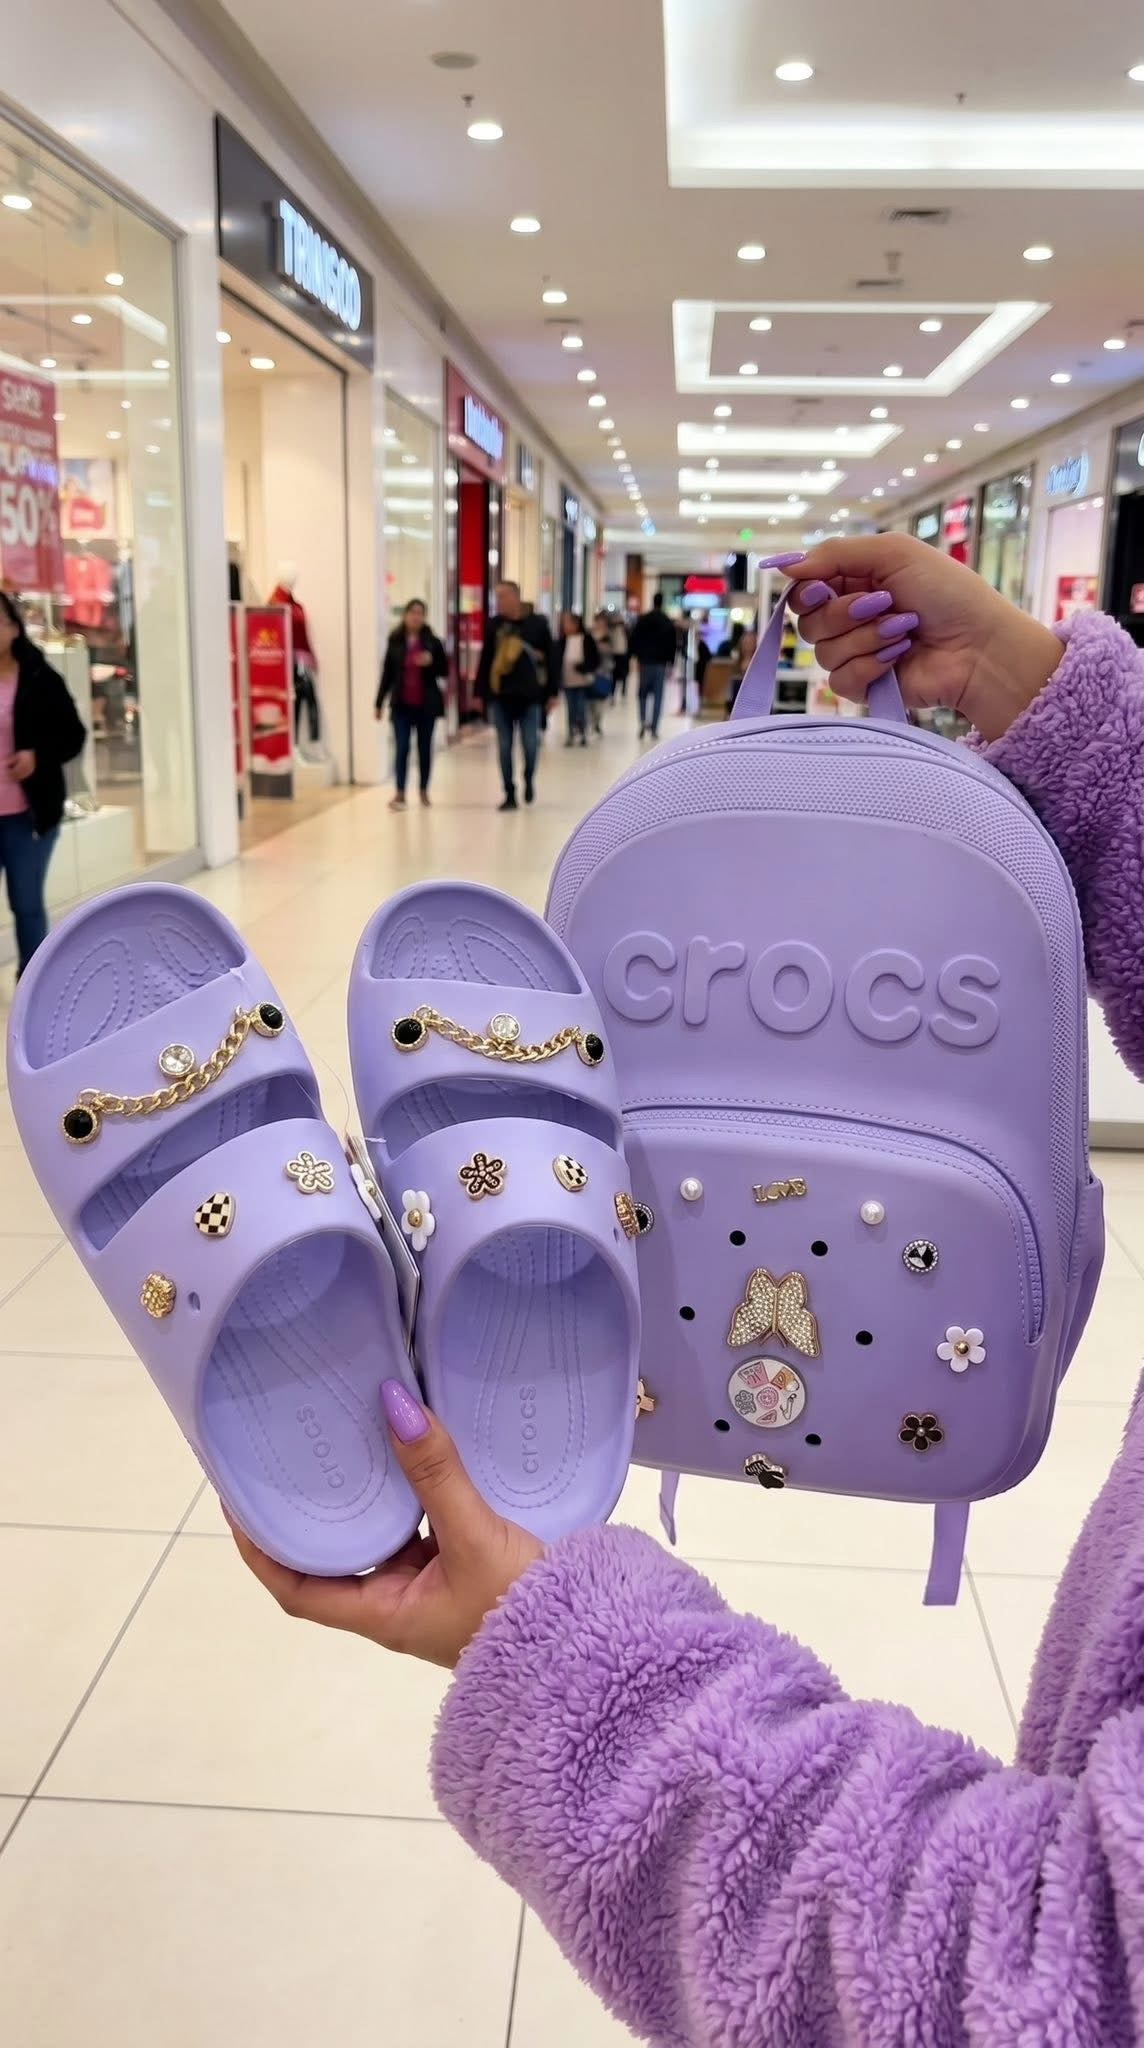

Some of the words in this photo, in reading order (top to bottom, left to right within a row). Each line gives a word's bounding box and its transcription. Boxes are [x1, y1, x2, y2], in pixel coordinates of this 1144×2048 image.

[603, 930, 1001, 1050] crocs
[296, 1404, 345, 1489] crocs
[520, 1385, 539, 1474] crocs
